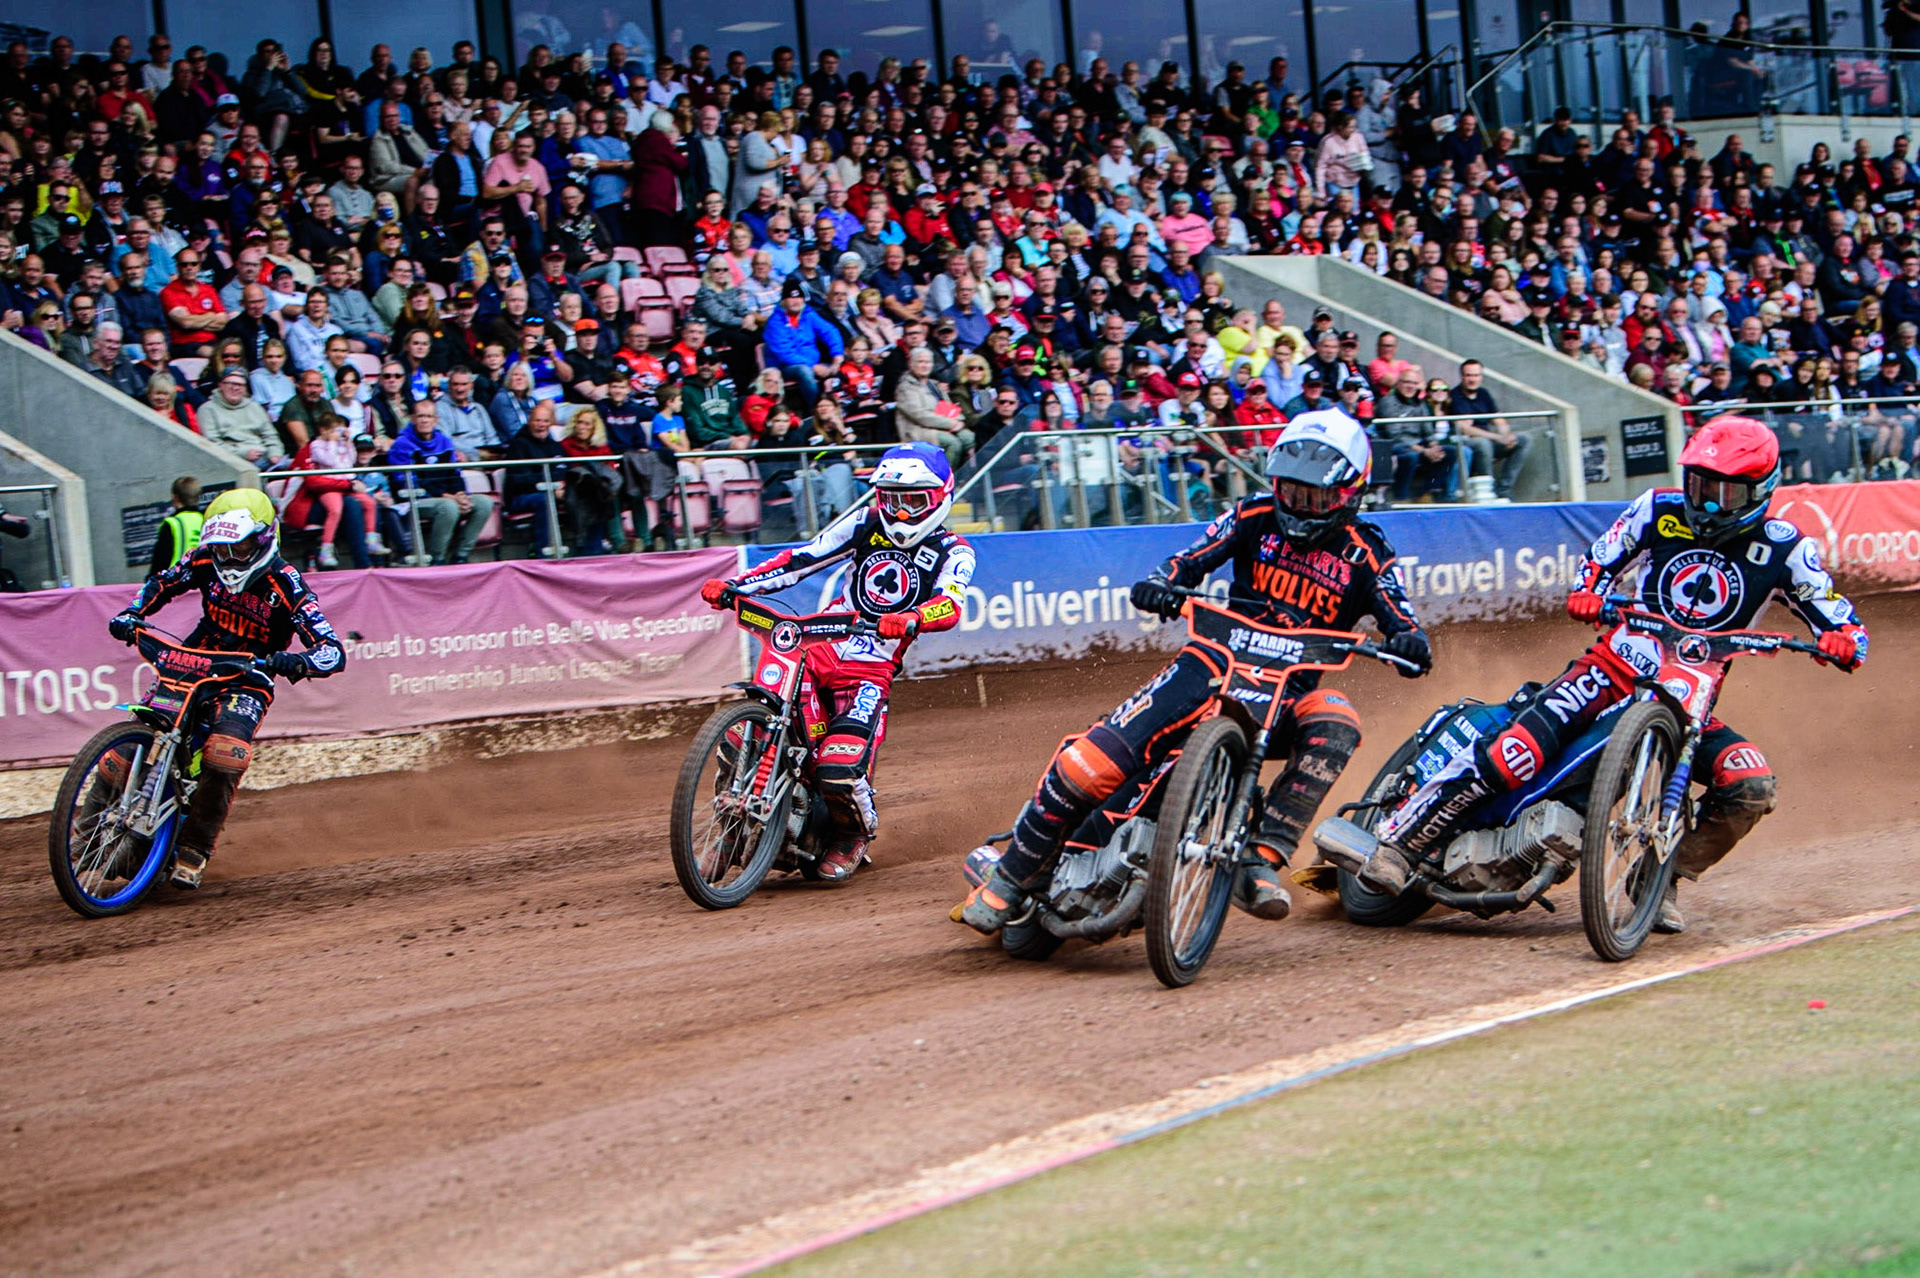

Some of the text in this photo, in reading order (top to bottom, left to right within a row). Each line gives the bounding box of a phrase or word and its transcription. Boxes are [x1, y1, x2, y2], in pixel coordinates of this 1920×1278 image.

[1843, 530, 1920, 564] CORPO
[866, 552, 917, 588] BELLE VUE ACES
[1398, 548, 1504, 597] Travel
[1669, 554, 1739, 595] BELLE VUE ACES
[1252, 561, 1342, 624] WOLVES
[207, 600, 270, 643] WOLVES
[345, 637, 400, 661] Proud
[404, 636, 426, 656] to
[429, 630, 508, 659] sponsor
[511, 625, 544, 648] the
[547, 621, 594, 645] Belle
[595, 620, 631, 643] Vue
[632, 612, 724, 641] Speedway
[0, 664, 119, 717] ITORS
[389, 666, 502, 696] Premiership
[508, 661, 565, 685] Junior
[570, 657, 634, 684] League
